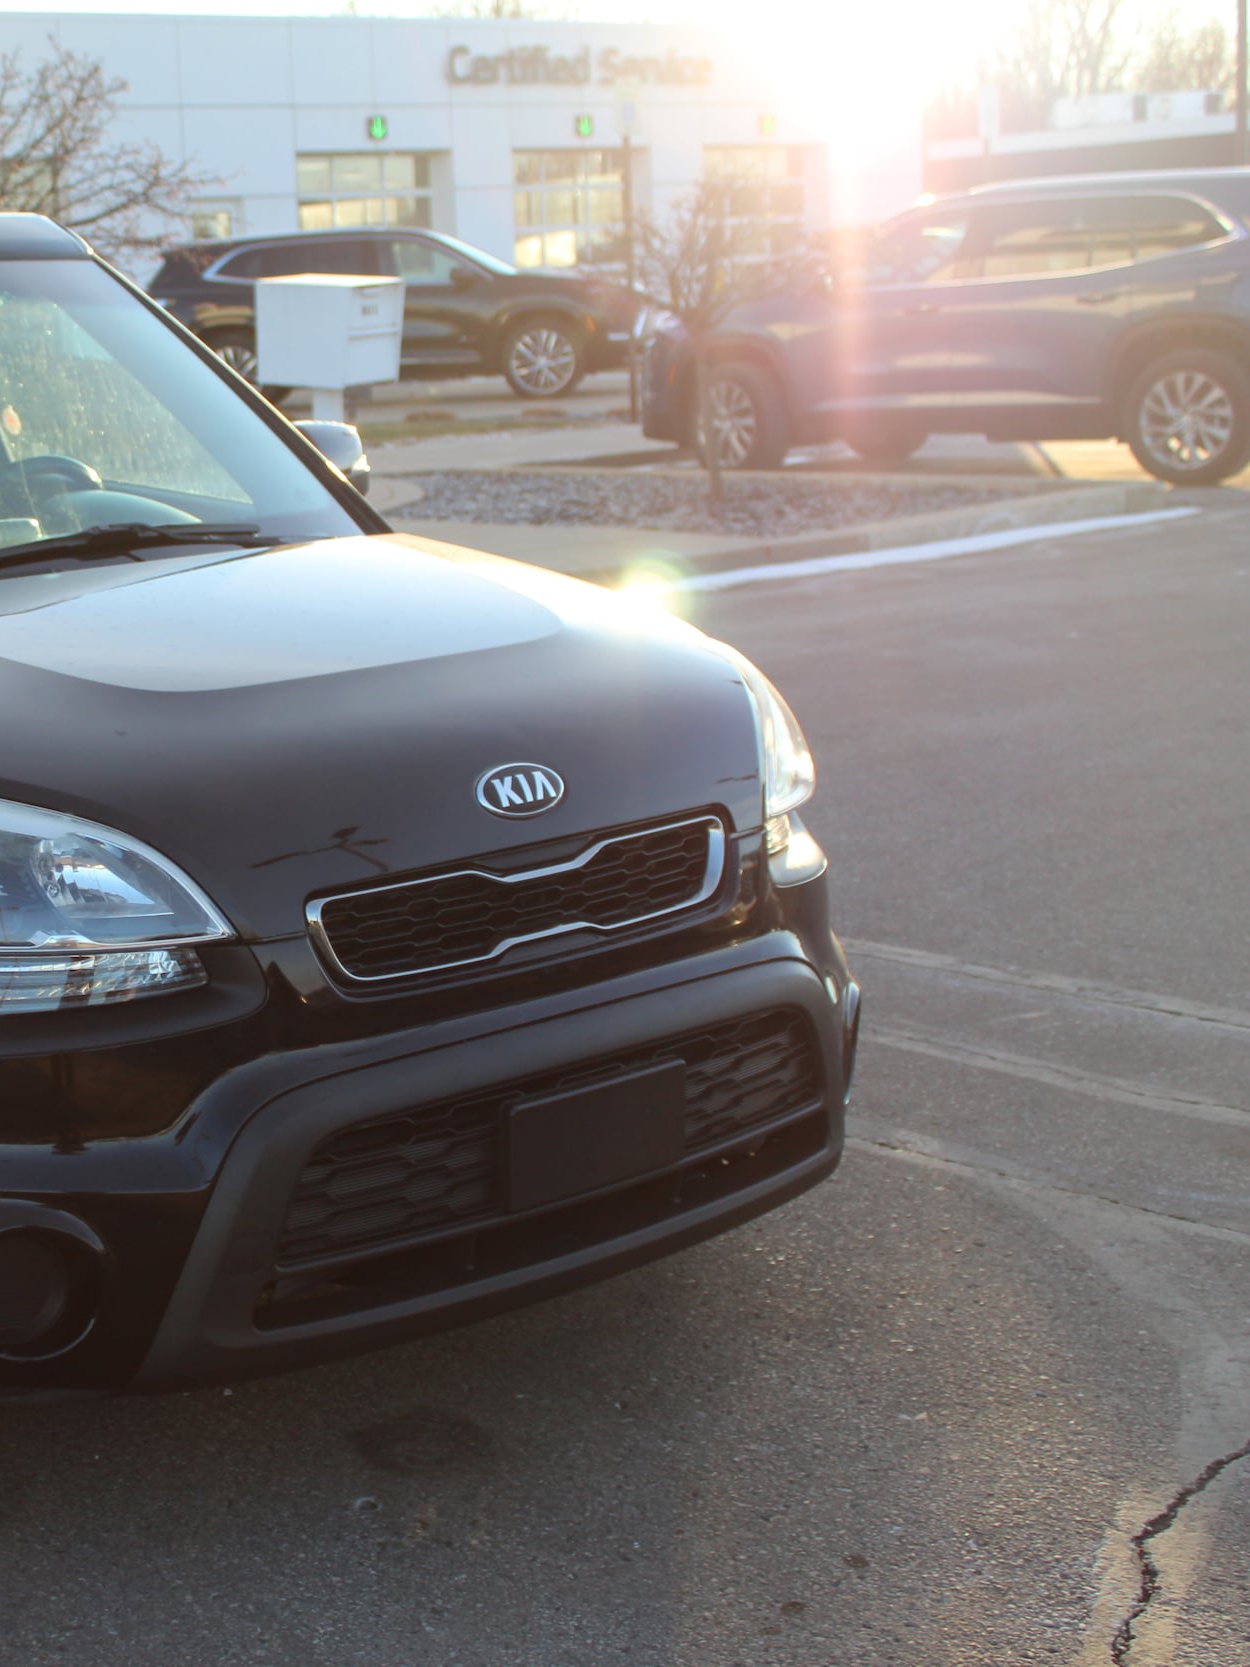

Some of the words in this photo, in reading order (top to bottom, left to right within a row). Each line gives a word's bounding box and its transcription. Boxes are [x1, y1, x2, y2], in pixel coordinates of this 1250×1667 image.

[444, 44, 590, 86] Certified
[596, 47, 713, 87] Service
[490, 770, 557, 808] KIA
